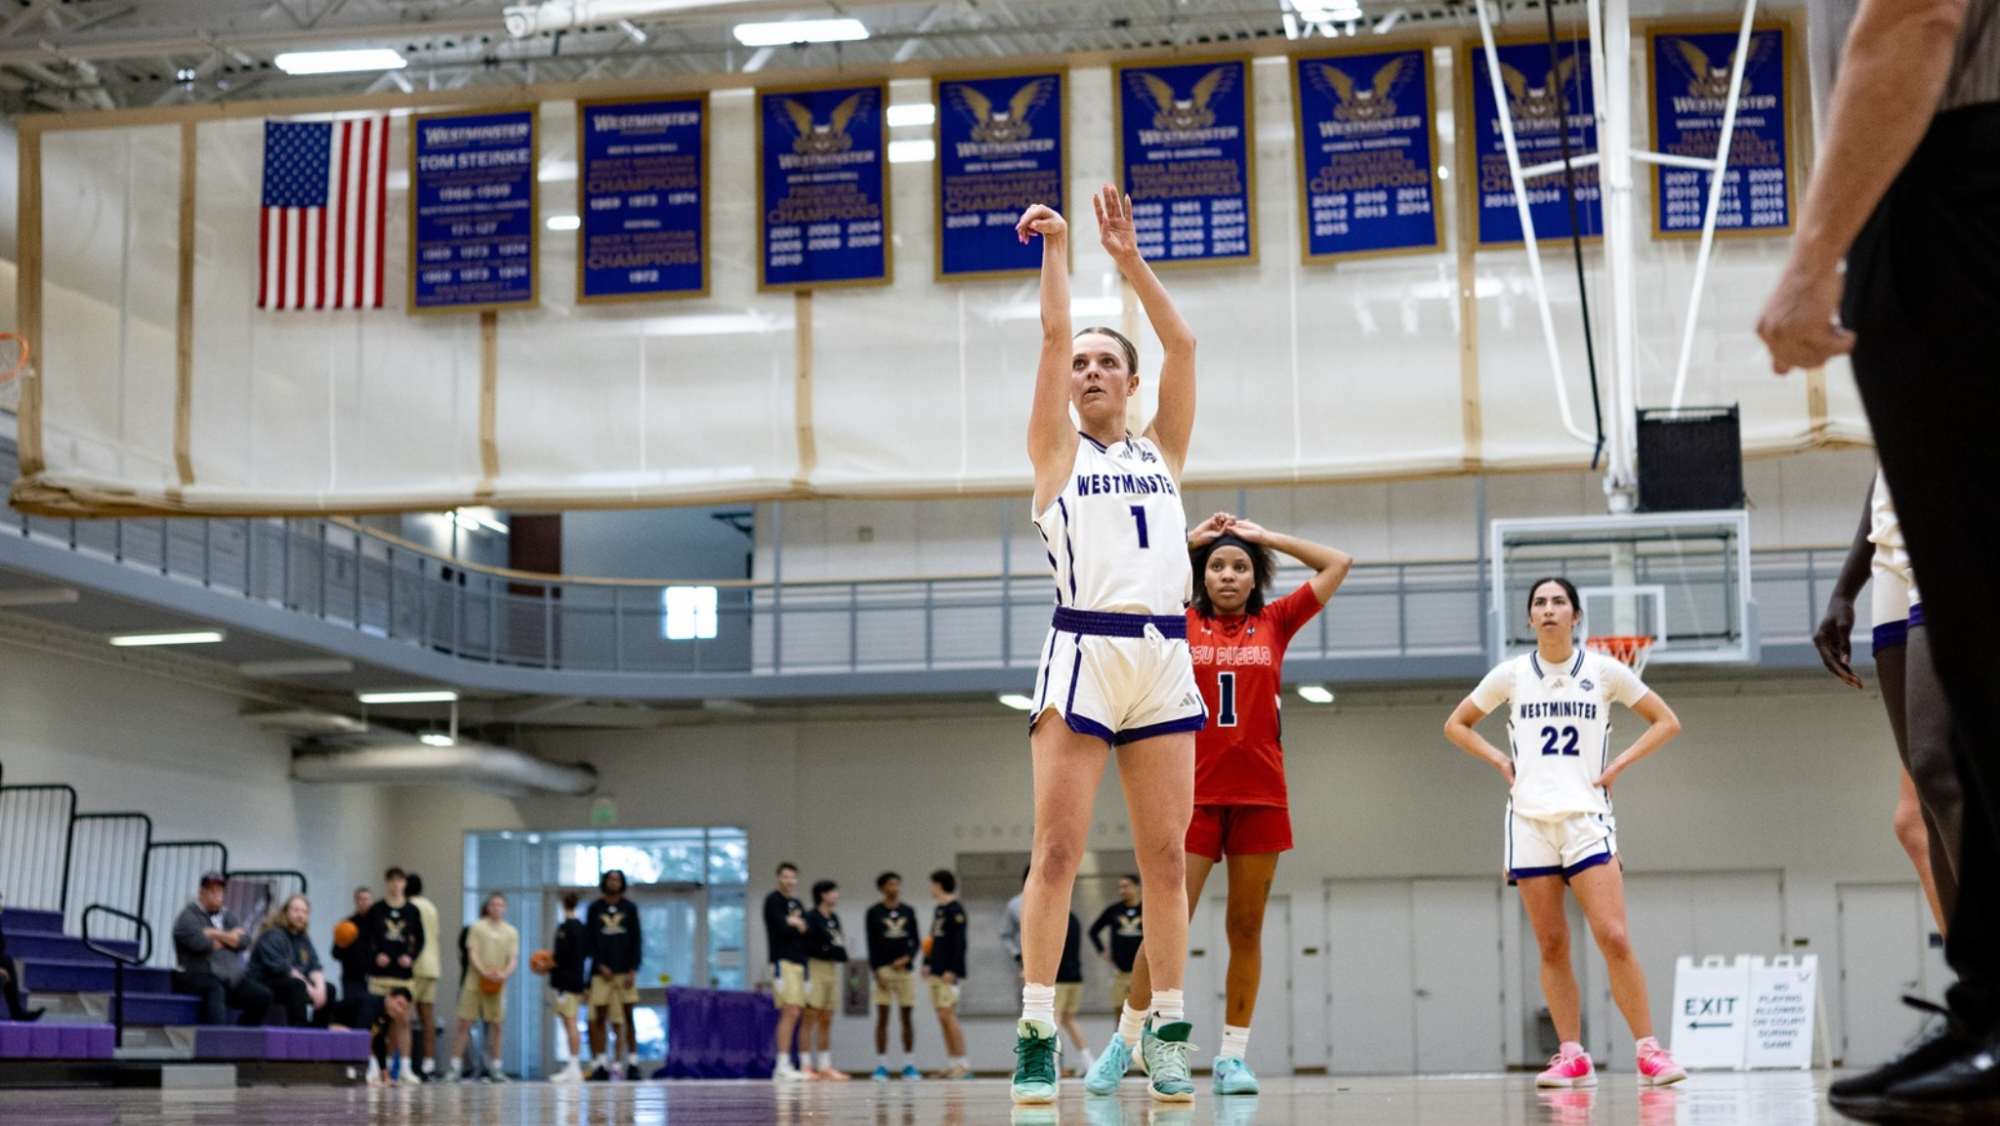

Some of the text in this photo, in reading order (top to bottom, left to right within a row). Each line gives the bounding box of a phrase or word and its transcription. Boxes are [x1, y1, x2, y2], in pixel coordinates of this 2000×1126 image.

[1318, 115, 1421, 138] WESTMINSTER
[418, 148, 530, 171] TOM STEINKE
[588, 176, 698, 194] CHAMPIONS
[946, 181, 1057, 197] TOURNAMENT
[1309, 168, 1428, 193] CHAMPIONS
[1397, 186, 1427, 201] 2011
[1574, 187, 1599, 201] 015
[1666, 185, 1700, 200] 2010
[767, 203, 880, 225] CHAMPIONS
[1716, 211, 1744, 227] 020
[1750, 210, 1784, 226] 2021
[588, 250, 698, 270] CHAMPIONS
[1130, 505, 1150, 549] 1
[1191, 646, 1272, 667] SU PUEBLO
[1217, 671, 1237, 727] 1
[1520, 701, 1597, 720] WESTMINSTER
[1540, 725, 1580, 756] 22
[1684, 997, 1739, 1016] EXIT
